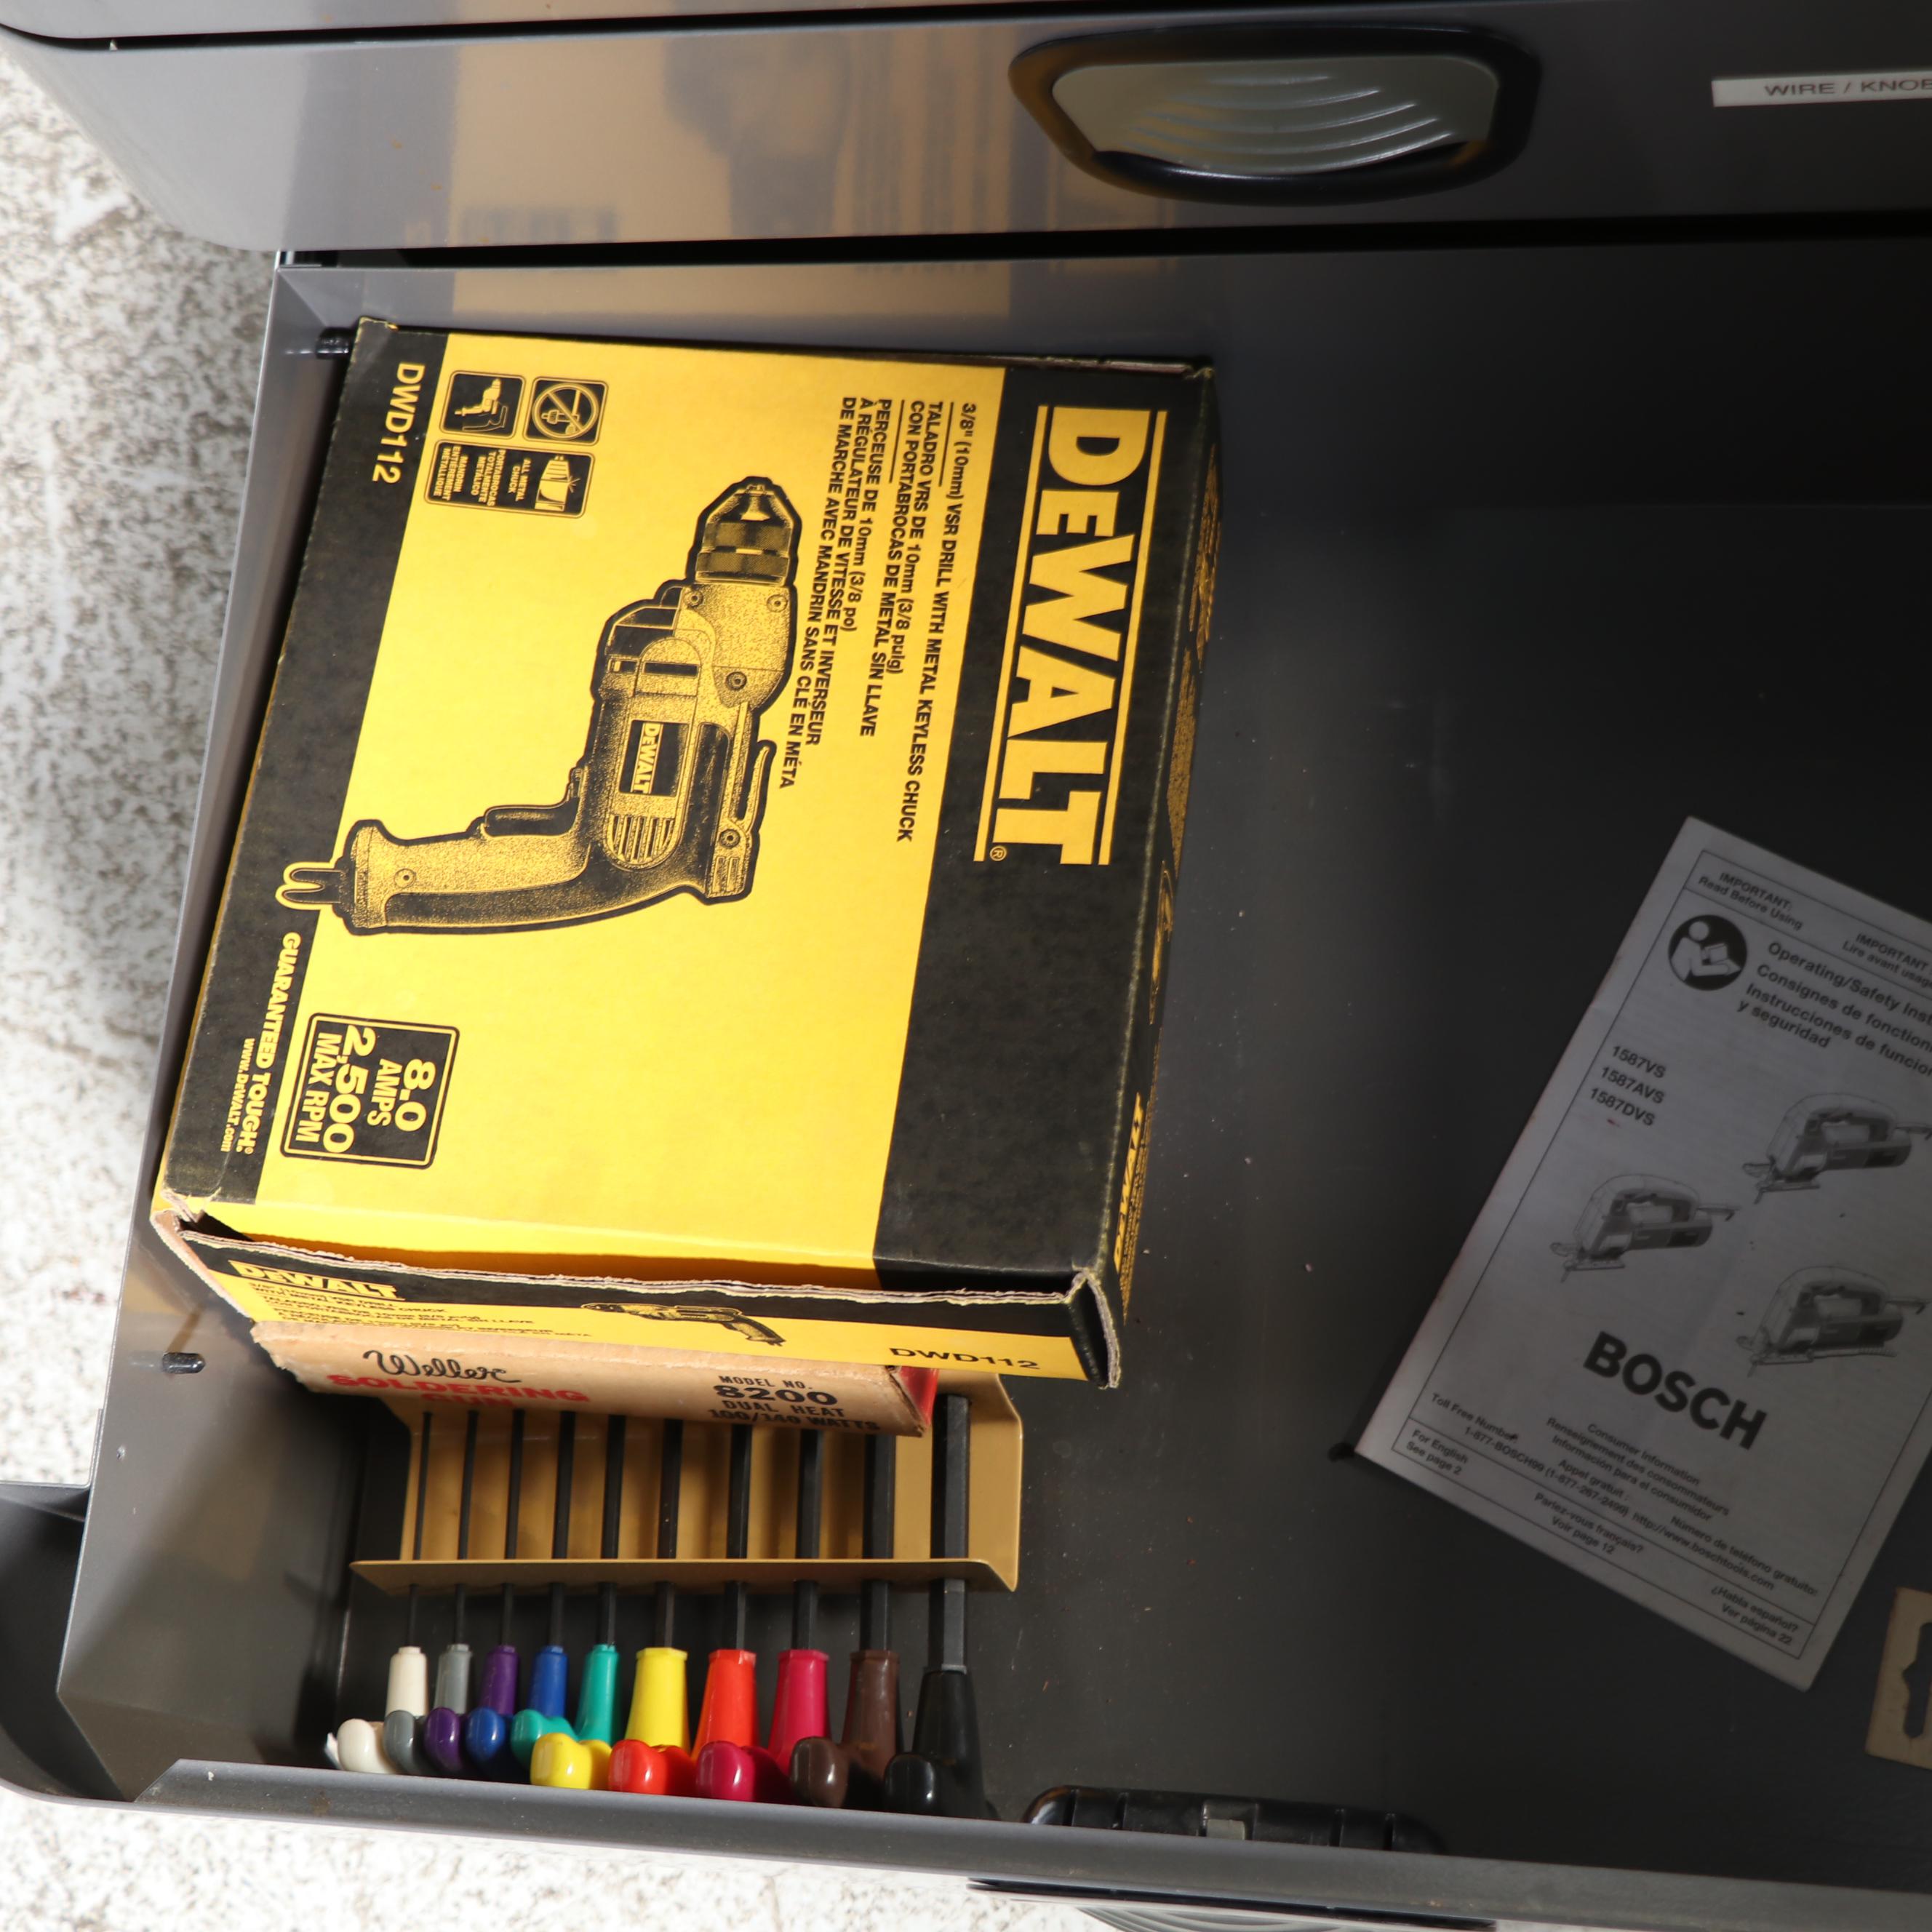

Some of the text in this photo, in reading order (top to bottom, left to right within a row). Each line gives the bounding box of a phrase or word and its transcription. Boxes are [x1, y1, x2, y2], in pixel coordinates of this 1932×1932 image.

[1765, 82, 1835, 97] WIRE
[372, 363, 425, 483] DWD112
[434, 447, 452, 496] MÉTALLIQUE
[453, 455, 468, 492] MANDRIN
[471, 456, 490, 496] METÁLICO
[479, 452, 496, 503] TOTALMENTE
[485, 449, 506, 508] PORTABROCAS
[508, 466, 521, 493] CHUCK
[515, 459, 531, 501] ALL METAL
[840, 399, 893, 631] PERCEUSE DE 10mm (3/8 po)
[886, 401, 943, 674] TALADRO VRS DE 10mm (3/8 pulg)
[806, 398, 877, 745] À RÉGULATEUR DE VITESSE ET INVERSEUR
[861, 401, 925, 736] CON PORTABROCAS DE METAL SIN LLAVE
[780, 397, 857, 788] DE MARCHE AVEC MANDRIN SANS CLÉ EN MÉTA
[897, 403, 976, 841] 3/8" (10mm) VSR DRILL WITH METAL KEYLESS CHUCK
[989, 407, 1150, 864] DEWALT
[631, 722, 662, 794] DEWALT
[1699, 877, 1803, 931] Read Before Using
[1768, 942, 1901, 1011] Operating/Safety
[1843, 941, 1865, 957] Lire
[1867, 954, 1899, 973] avant
[256, 933, 301, 1069] GUARANTEED
[1757, 964, 1839, 1010] Consignes
[1842, 1005, 1862, 1020] de
[1737, 1001, 1832, 1047] y seguridad
[1747, 983, 1852, 1039] Instrucciones
[1855, 1035, 1875, 1050] de
[1602, 1067, 1664, 1103] 1587AVS
[1613, 1046, 1666, 1078] 1587VS
[295, 1032, 343, 1142] MAX RPM
[322, 1025, 377, 1153] 2,500
[367, 1058, 402, 1126] AMPS
[394, 1059, 436, 1131] 8.0
[1591, 1088, 1655, 1126] 1587DVS
[234, 1264, 398, 1299] DEWALT
[362, 1349, 522, 1384] Weller
[889, 1347, 1041, 1370] DWD112
[326, 1373, 591, 1403] SOLDERING
[421, 1392, 516, 1407] GUN
[713, 1384, 838, 1406] 8200
[719, 1375, 813, 1390] MODEL NO.
[1584, 1331, 1767, 1450] BOSCH
[722, 1400, 845, 1418] DUAL HEAT
[805, 1416, 881, 1432] WATTS
[1432, 1393, 1451, 1408] Toll
[1451, 1403, 1474, 1421] Free
[1407, 1441, 1462, 1475] See page 2
[1412, 1429, 1469, 1464] For English
[1465, 1426, 1545, 1472] 1-877-BOSCH99
[1546, 1418, 1729, 1516] Renseignement des consommateurs
[1588, 1424, 1700, 1486] Consumer Information
[1552, 1435, 1712, 1521] Información para el consumidor
[1558, 1459, 1589, 1480] Appel
[1589, 1477, 1624, 1498] gratuit
[1535, 1493, 1594, 1529] Parlez-vous
[1552, 1516, 1616, 1554] Voir page 12
[1671, 1516, 1712, 1542] Número
[1714, 1540, 1728, 1550] de
[1729, 1546, 1771, 1573] teléfono
[1723, 1603, 1740, 1617] Ver
[1778, 1633, 1792, 1645] 22
